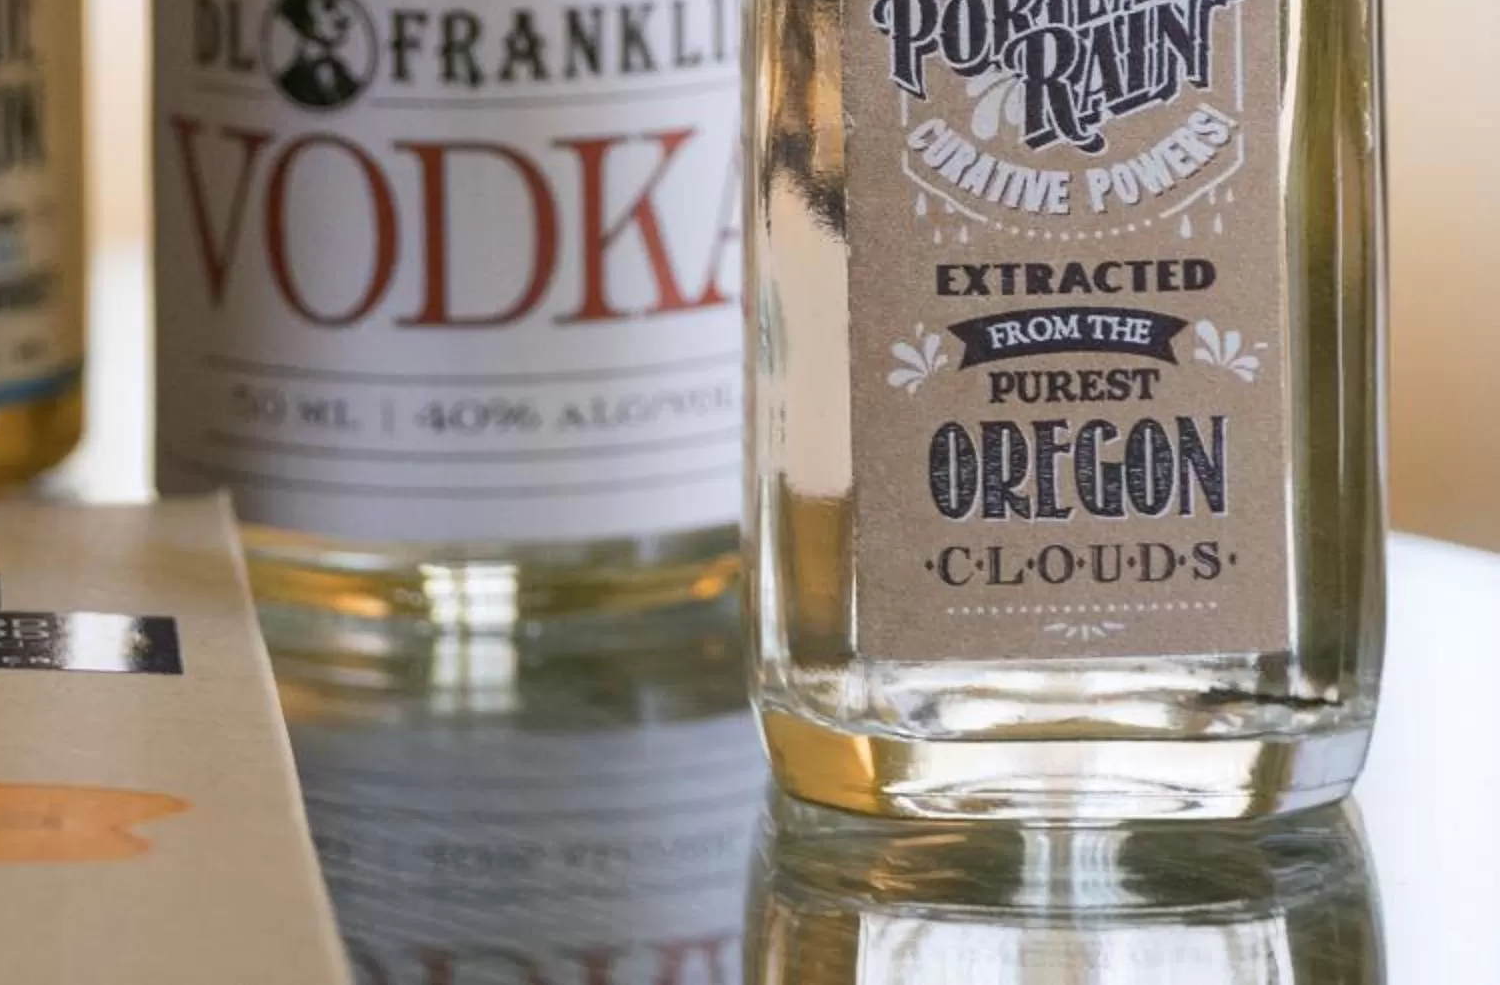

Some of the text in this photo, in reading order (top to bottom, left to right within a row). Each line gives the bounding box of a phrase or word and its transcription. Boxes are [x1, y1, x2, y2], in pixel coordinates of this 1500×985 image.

[907, 117, 1071, 215] CURATIVE
[935, 259, 1217, 296] EXTRACTED
[987, 315, 1153, 350] FROM THE
[988, 368, 1161, 404] PUREST
[928, 415, 1229, 522] OREGON
